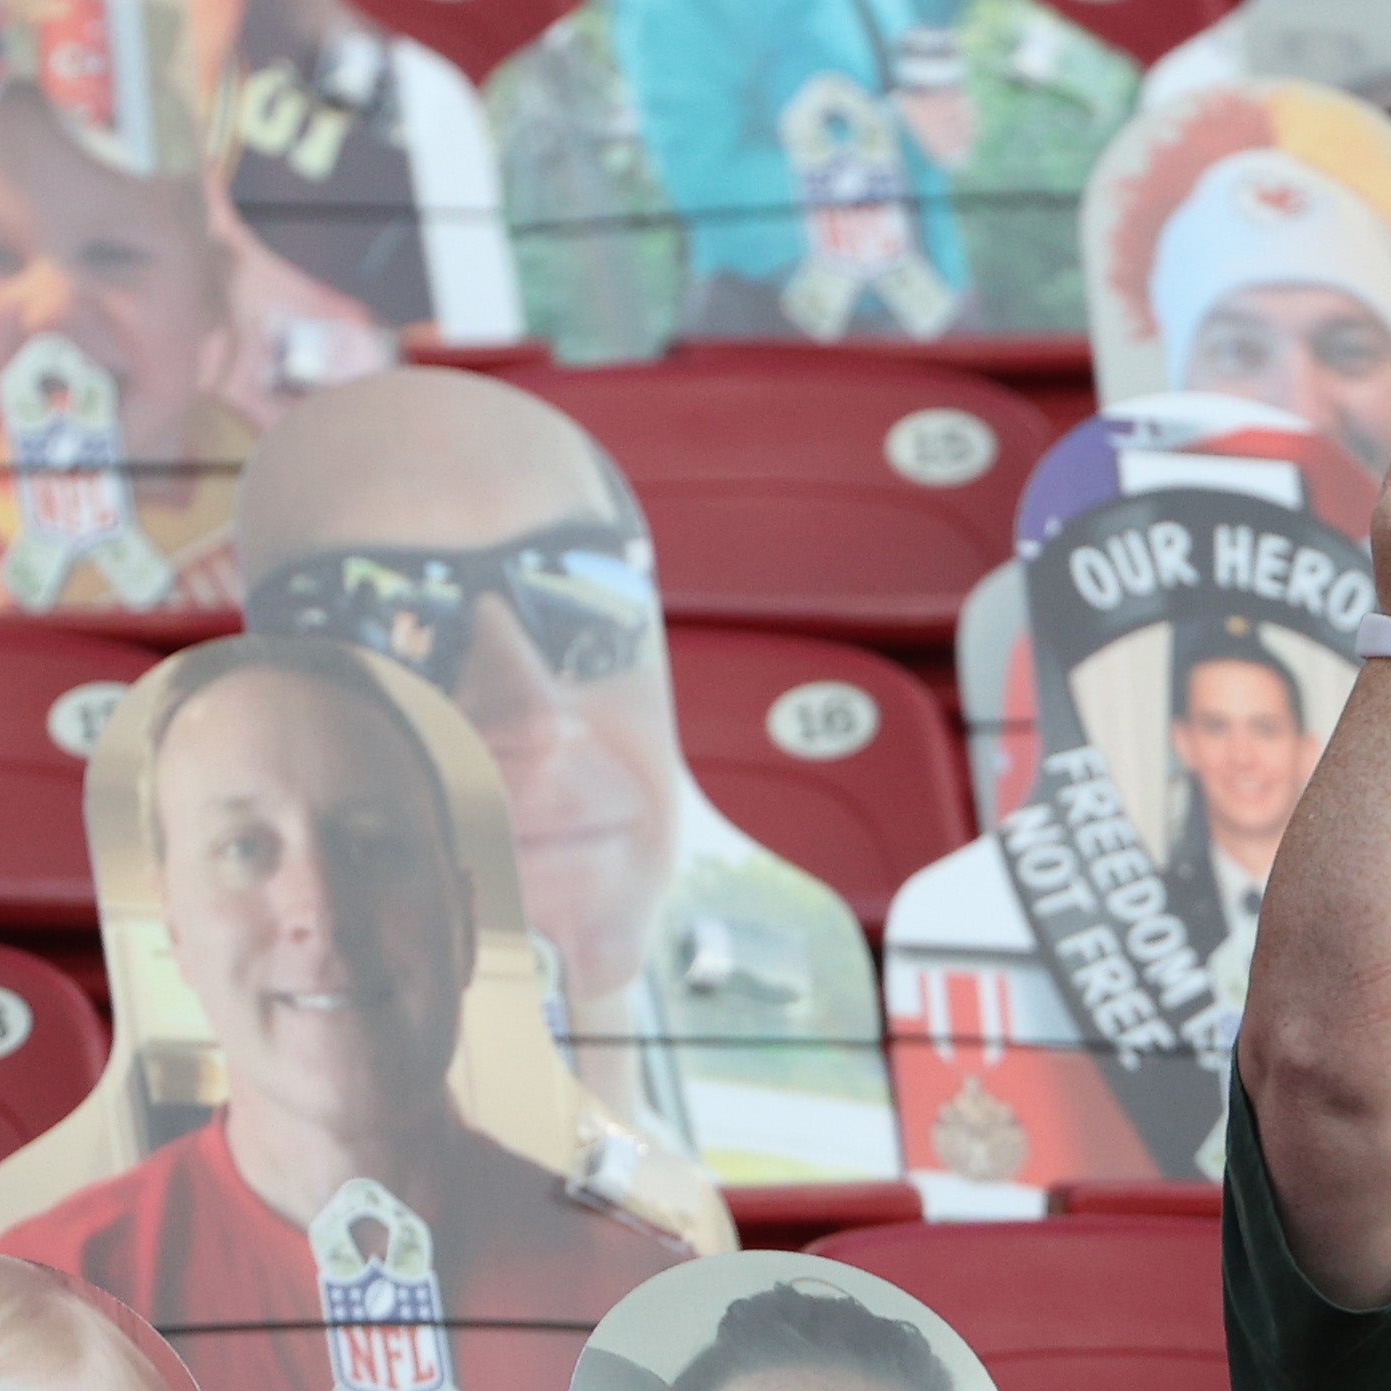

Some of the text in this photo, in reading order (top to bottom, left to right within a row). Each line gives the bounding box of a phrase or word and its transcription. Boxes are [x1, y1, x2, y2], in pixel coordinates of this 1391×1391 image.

[1069, 520, 1378, 632] OUR HERO
[1000, 803, 1097, 917] NOT
[1043, 744, 1216, 1010] FREEDOM
[341, 1325, 437, 1391] NFL
